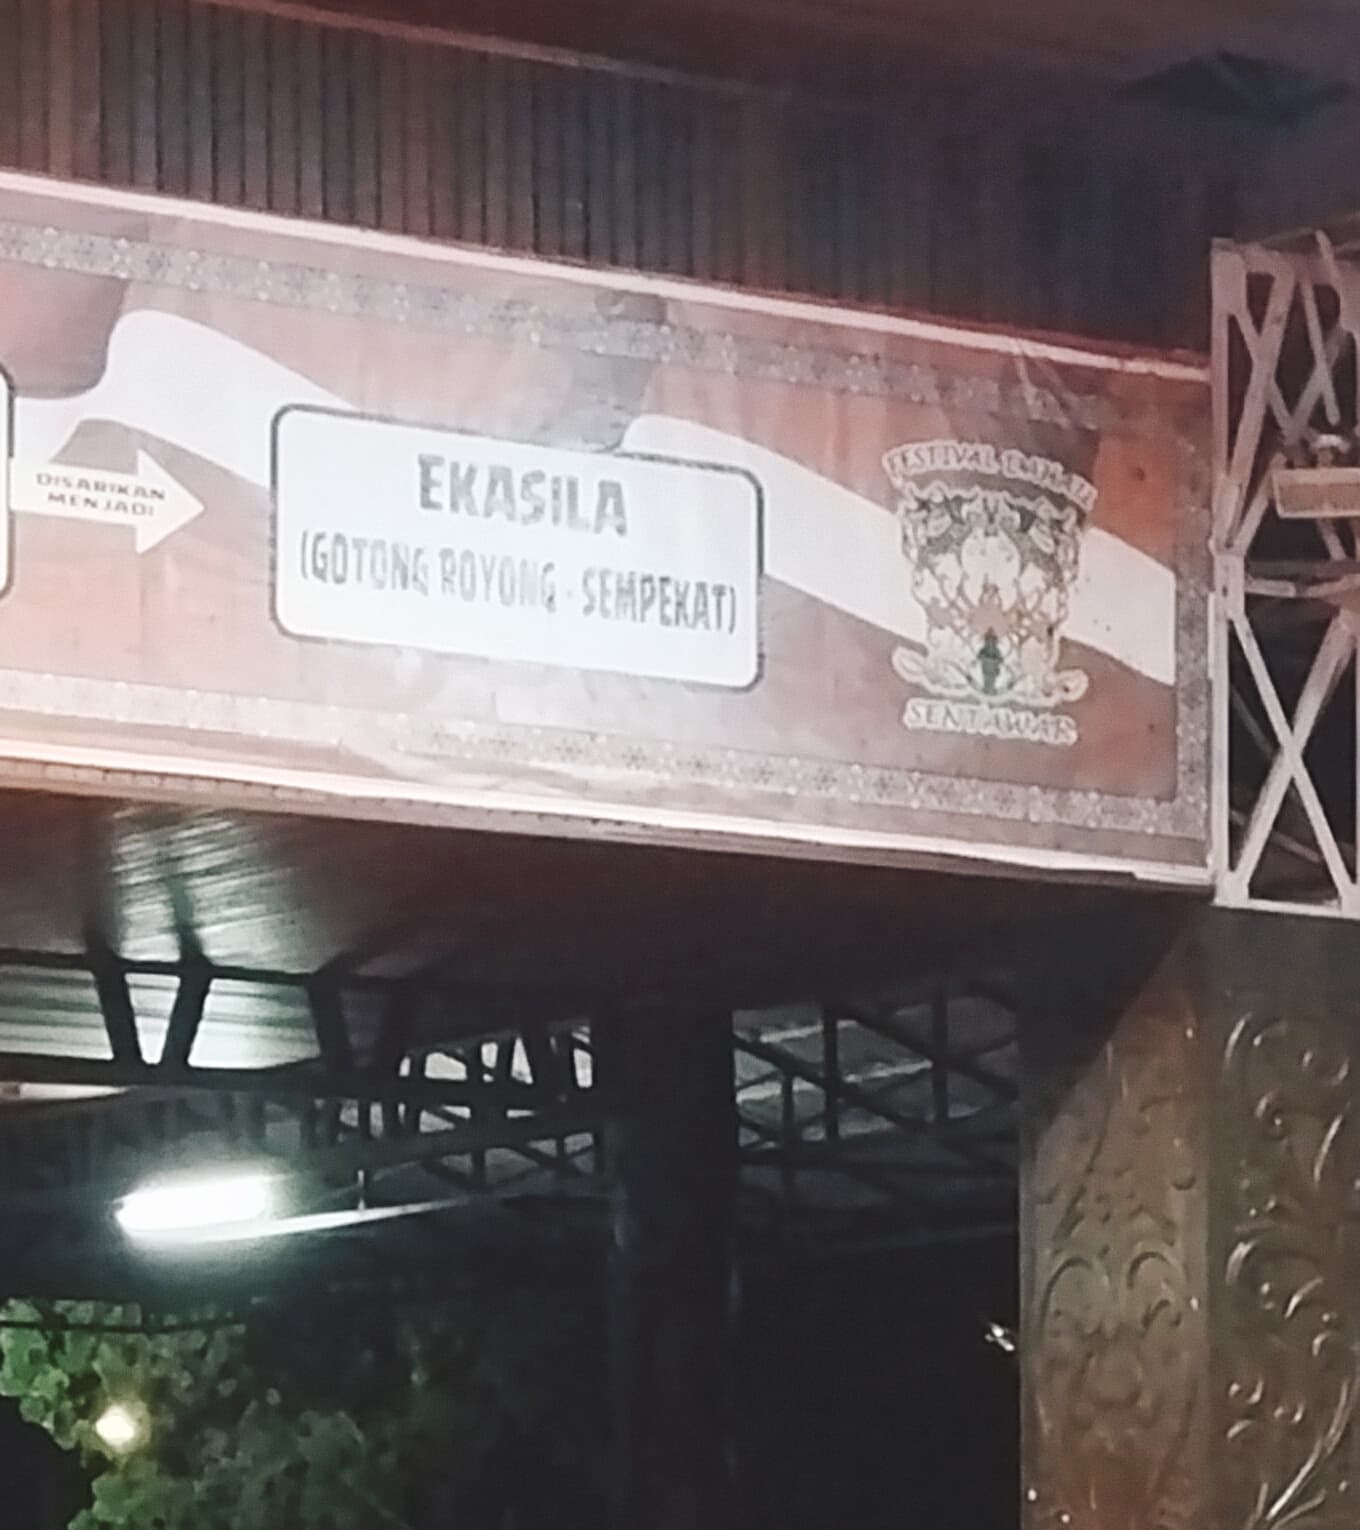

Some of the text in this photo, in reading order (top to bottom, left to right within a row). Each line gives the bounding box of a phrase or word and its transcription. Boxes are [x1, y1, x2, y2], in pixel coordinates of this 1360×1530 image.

[885, 442, 996, 481] FESTIVAL
[36, 473, 166, 500] DISARIKAN
[47, 491, 155, 517] MENJADI
[417, 453, 628, 536] EKASILA
[301, 529, 429, 598] (GOTONG
[439, 547, 556, 613] ROYONG
[582, 565, 737, 635] SEMPEKAT)
